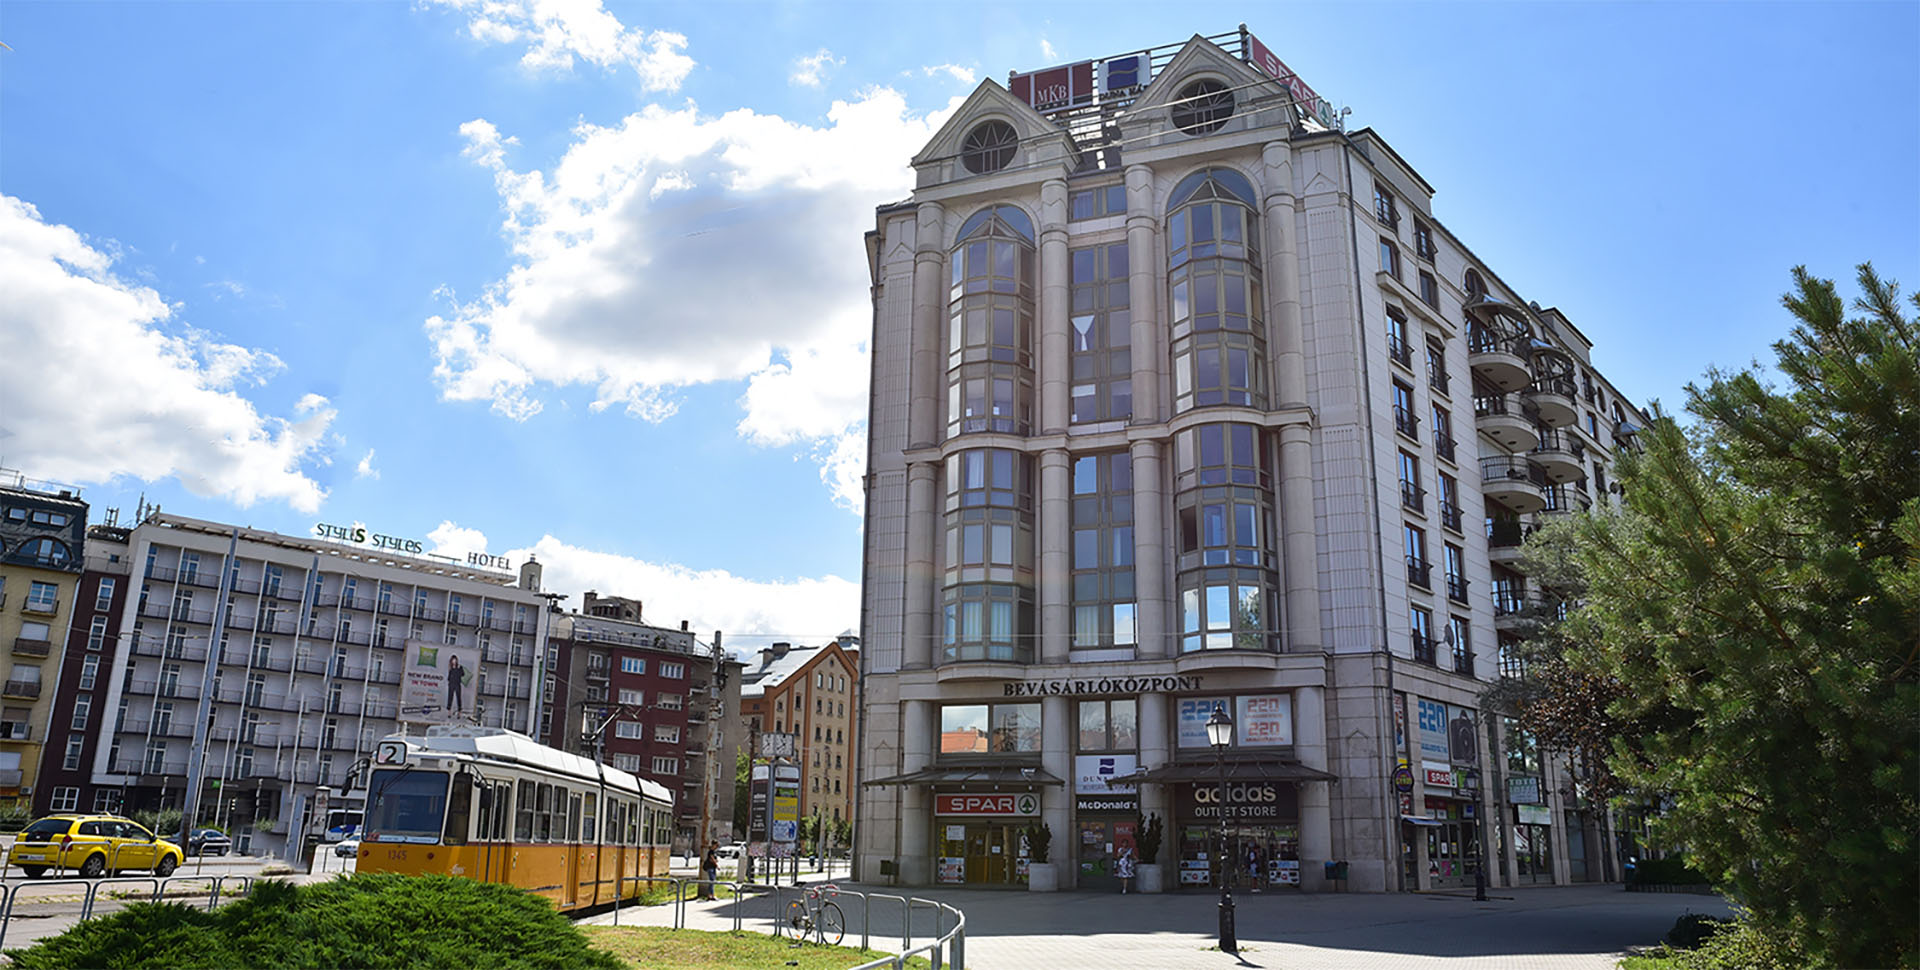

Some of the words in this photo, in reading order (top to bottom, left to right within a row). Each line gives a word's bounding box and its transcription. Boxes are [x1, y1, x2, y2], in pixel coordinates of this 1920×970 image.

[1265, 53, 1317, 111] SPAR
[1038, 84, 1067, 102] MKB
[467, 552, 512, 570] HOTEL
[1003, 676, 1203, 696] BEVÁSÁRLÓKÖZPONT
[1418, 700, 1446, 734] 220
[385, 746, 397, 762] 2
[1431, 772, 1451, 784] SPAR
[951, 798, 1013, 811] SPAR
[1078, 801, 1137, 810] McDonald's
[1240, 806, 1277, 817] STORE
[388, 850, 407, 860] 1345
